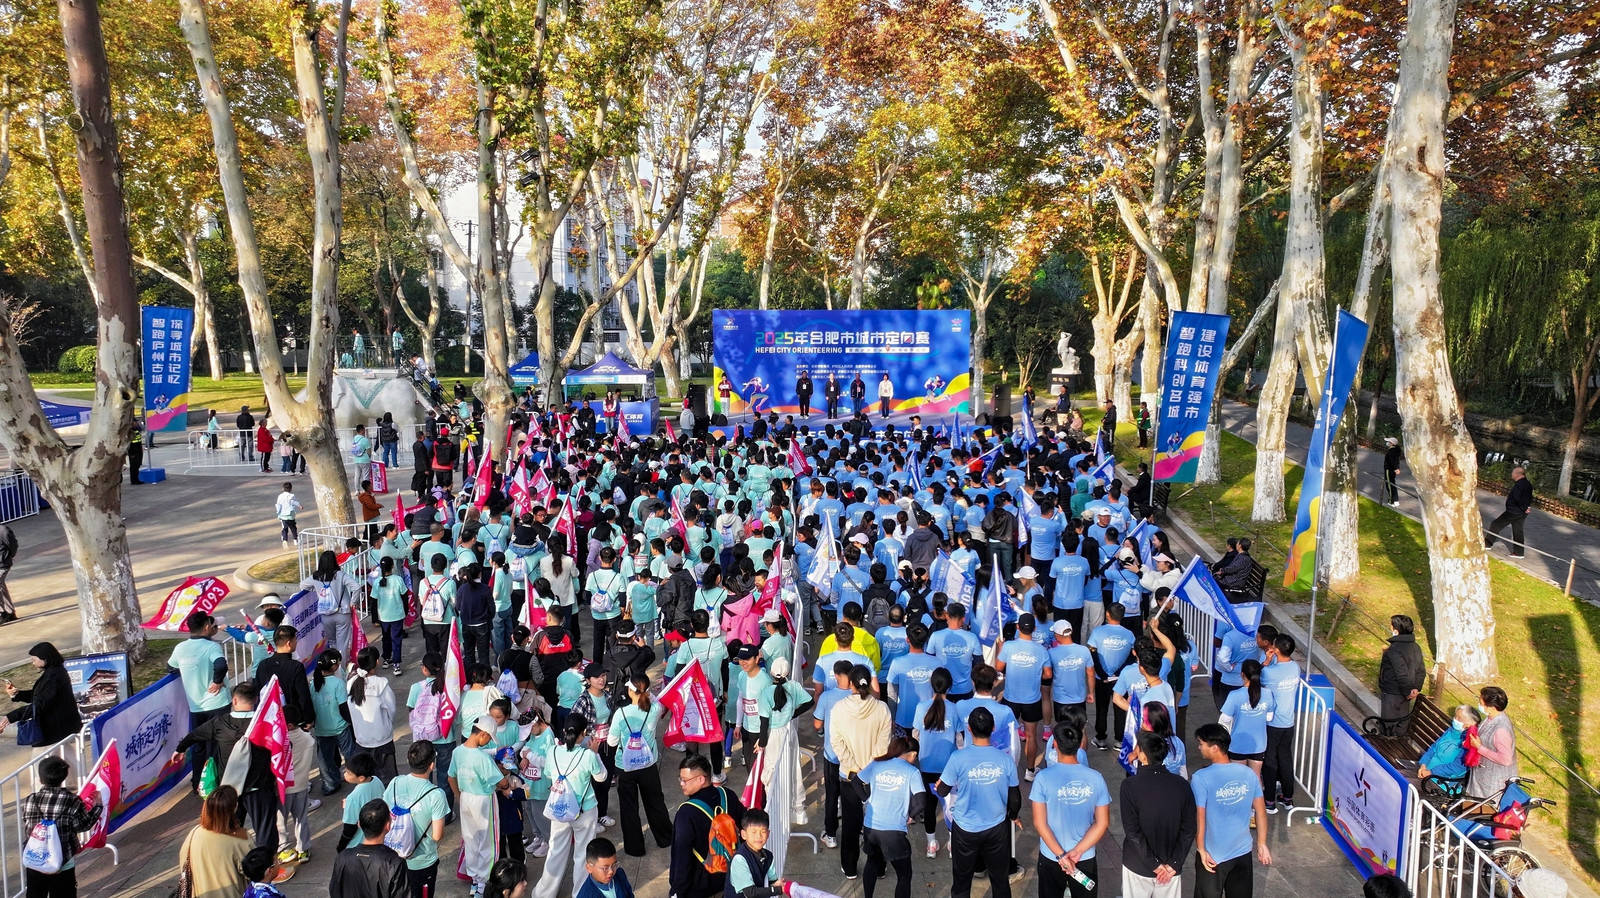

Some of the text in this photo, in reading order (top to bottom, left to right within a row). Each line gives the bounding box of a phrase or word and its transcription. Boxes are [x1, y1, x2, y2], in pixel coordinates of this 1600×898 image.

[152, 318, 165, 384] 智跑庐州古城
[167, 319, 183, 385] 探寻城市记忆
[755, 331, 930, 345] 2025年合肥市城市定向赛
[755, 346, 776, 354] HEFEI
[776, 346, 792, 354] CITY
[792, 346, 843, 354] ORIENTEERING
[1168, 326, 1196, 419] 智跑科创名城
[1184, 328, 1217, 419] 建设体育强市
[125, 714, 172, 760] 城市定向赛
